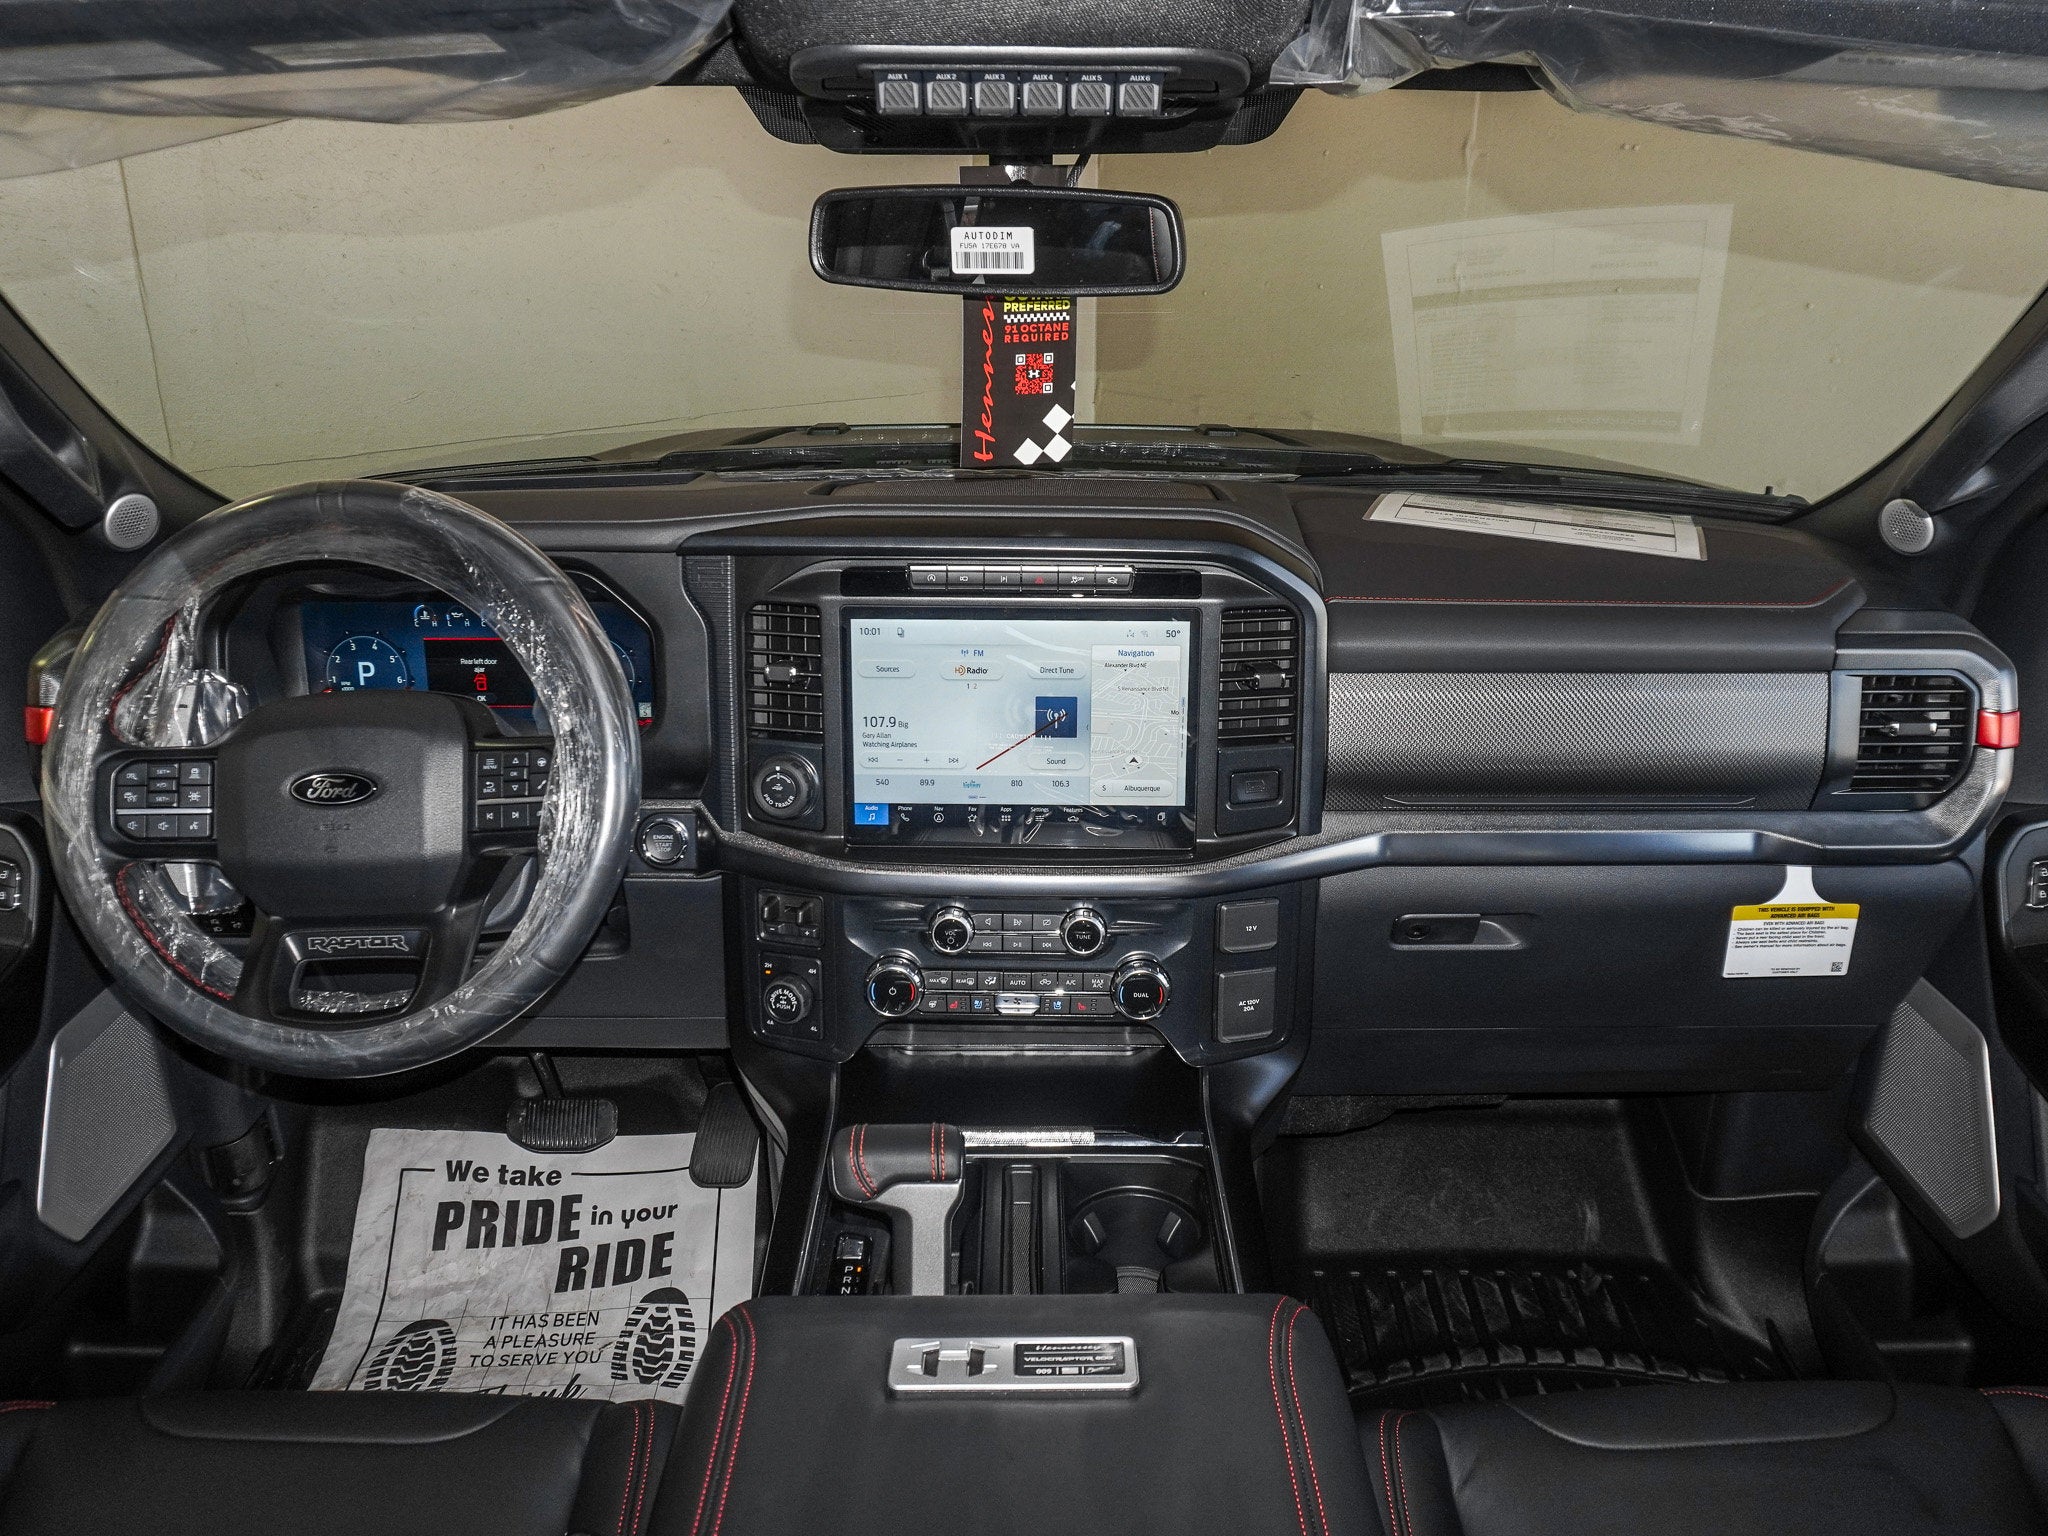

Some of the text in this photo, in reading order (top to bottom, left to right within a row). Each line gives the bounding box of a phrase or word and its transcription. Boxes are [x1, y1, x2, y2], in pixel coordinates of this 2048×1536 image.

[964, 231, 1013, 240] AUTODIM
[1003, 300, 1071, 313] PREFERRED
[1004, 322, 1069, 334] 91 OCTANE
[1004, 332, 1069, 343] REQUIRED
[859, 627, 881, 636] 10:01
[350, 643, 356, 651] 3
[371, 643, 378, 651] 4
[973, 649, 984, 657] FM
[1118, 649, 1155, 657] Navigation
[357, 661, 376, 686] P
[875, 665, 900, 673] Sources
[966, 667, 988, 675] Radio
[1039, 666, 1075, 674] Direct Tune
[396, 676, 403, 684] 6
[862, 716, 909, 729] 107.9 Big
[862, 732, 876, 740] Gary
[862, 741, 918, 749] Watching Airplanes
[306, 777, 358, 799] Ford
[1052, 780, 1070, 788] 106.3
[1124, 785, 1161, 793] Albuquerque
[307, 934, 409, 954] RAPTOR
[446, 1160, 563, 1187] We take
[432, 1193, 679, 1251] PRIDE in your
[554, 1231, 675, 1294] RIDE
[844, 1265, 854, 1273] P
[842, 1276, 852, 1284] R
[840, 1286, 851, 1295] N
[490, 1311, 600, 1331] IT HAS BEEN
[482, 1331, 597, 1350] A PLEASURE
[469, 1350, 604, 1368] TO SERVE YOU
